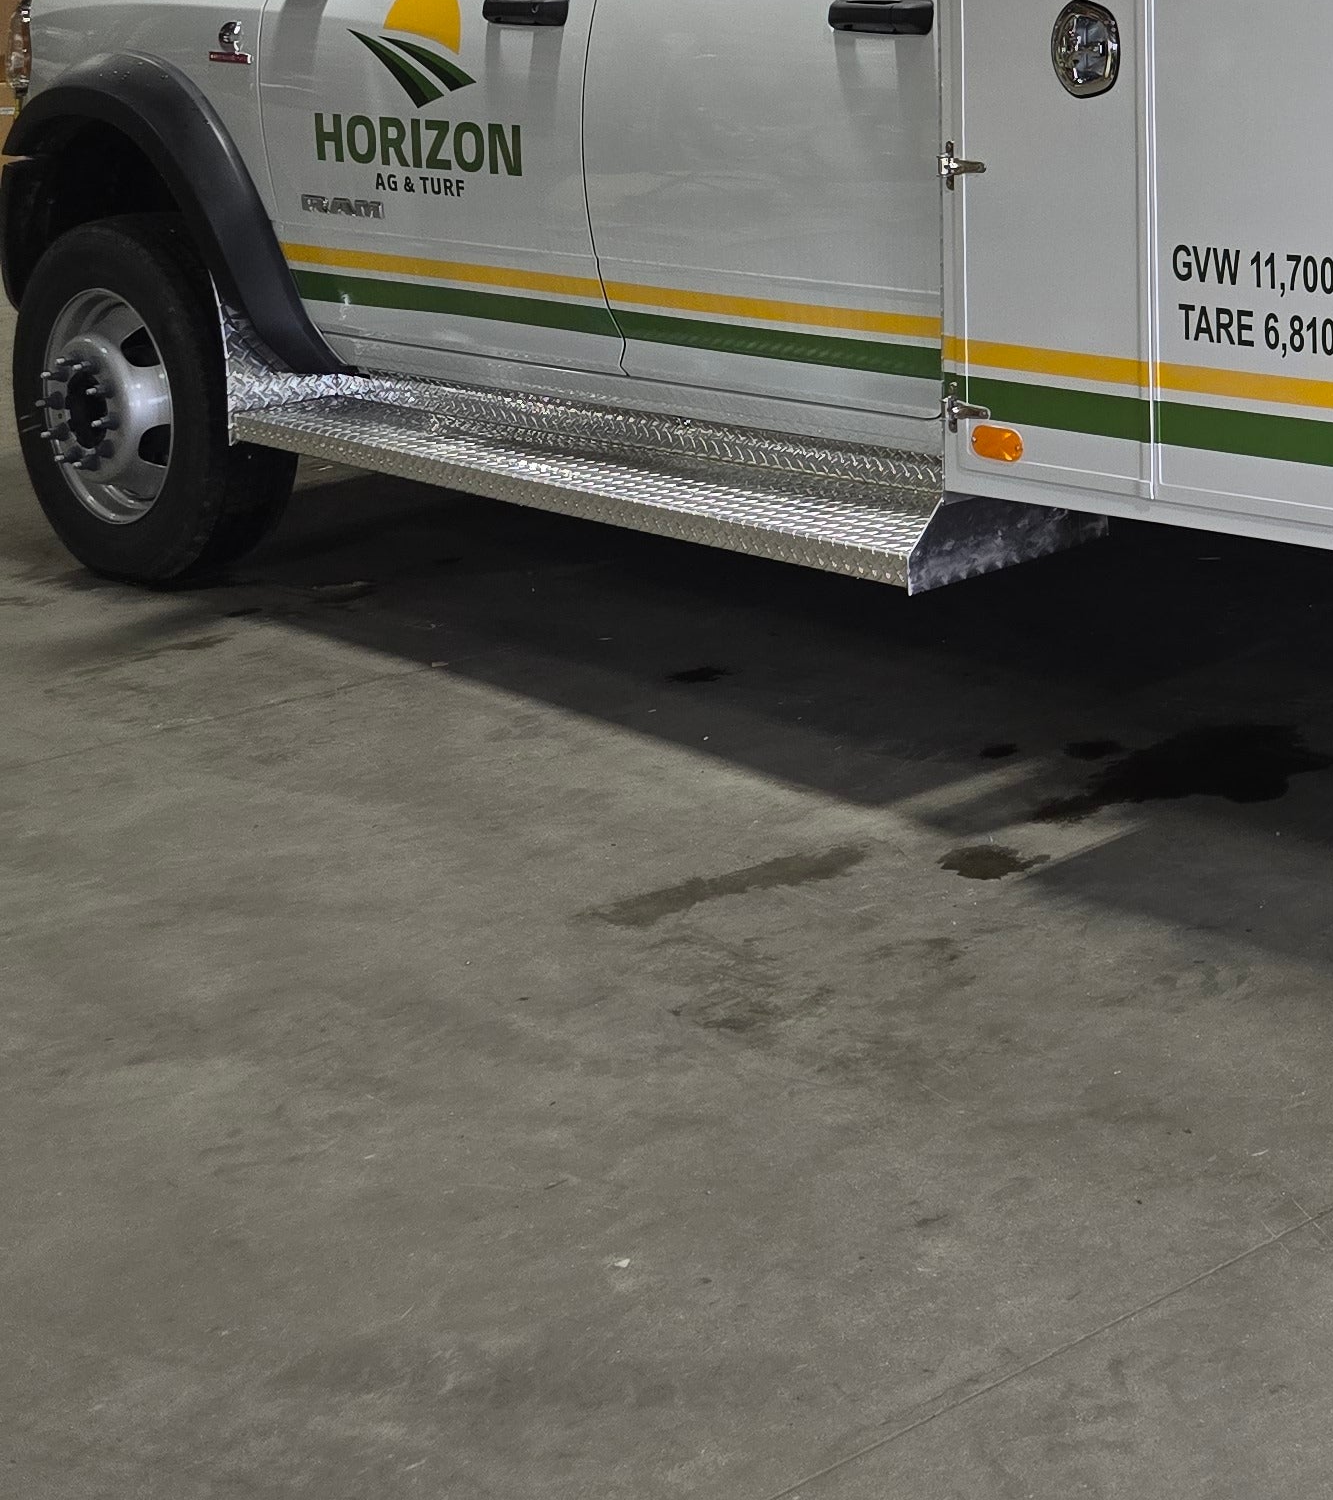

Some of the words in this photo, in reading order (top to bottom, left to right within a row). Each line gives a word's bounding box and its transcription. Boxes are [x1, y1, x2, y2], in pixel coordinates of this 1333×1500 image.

[314, 112, 523, 177] HORIZON
[375, 172, 399, 193] AG
[403, 175, 416, 193] &
[419, 176, 465, 198] TURF
[1172, 244, 1240, 286] GVW
[1178, 303, 1255, 348] TARE
